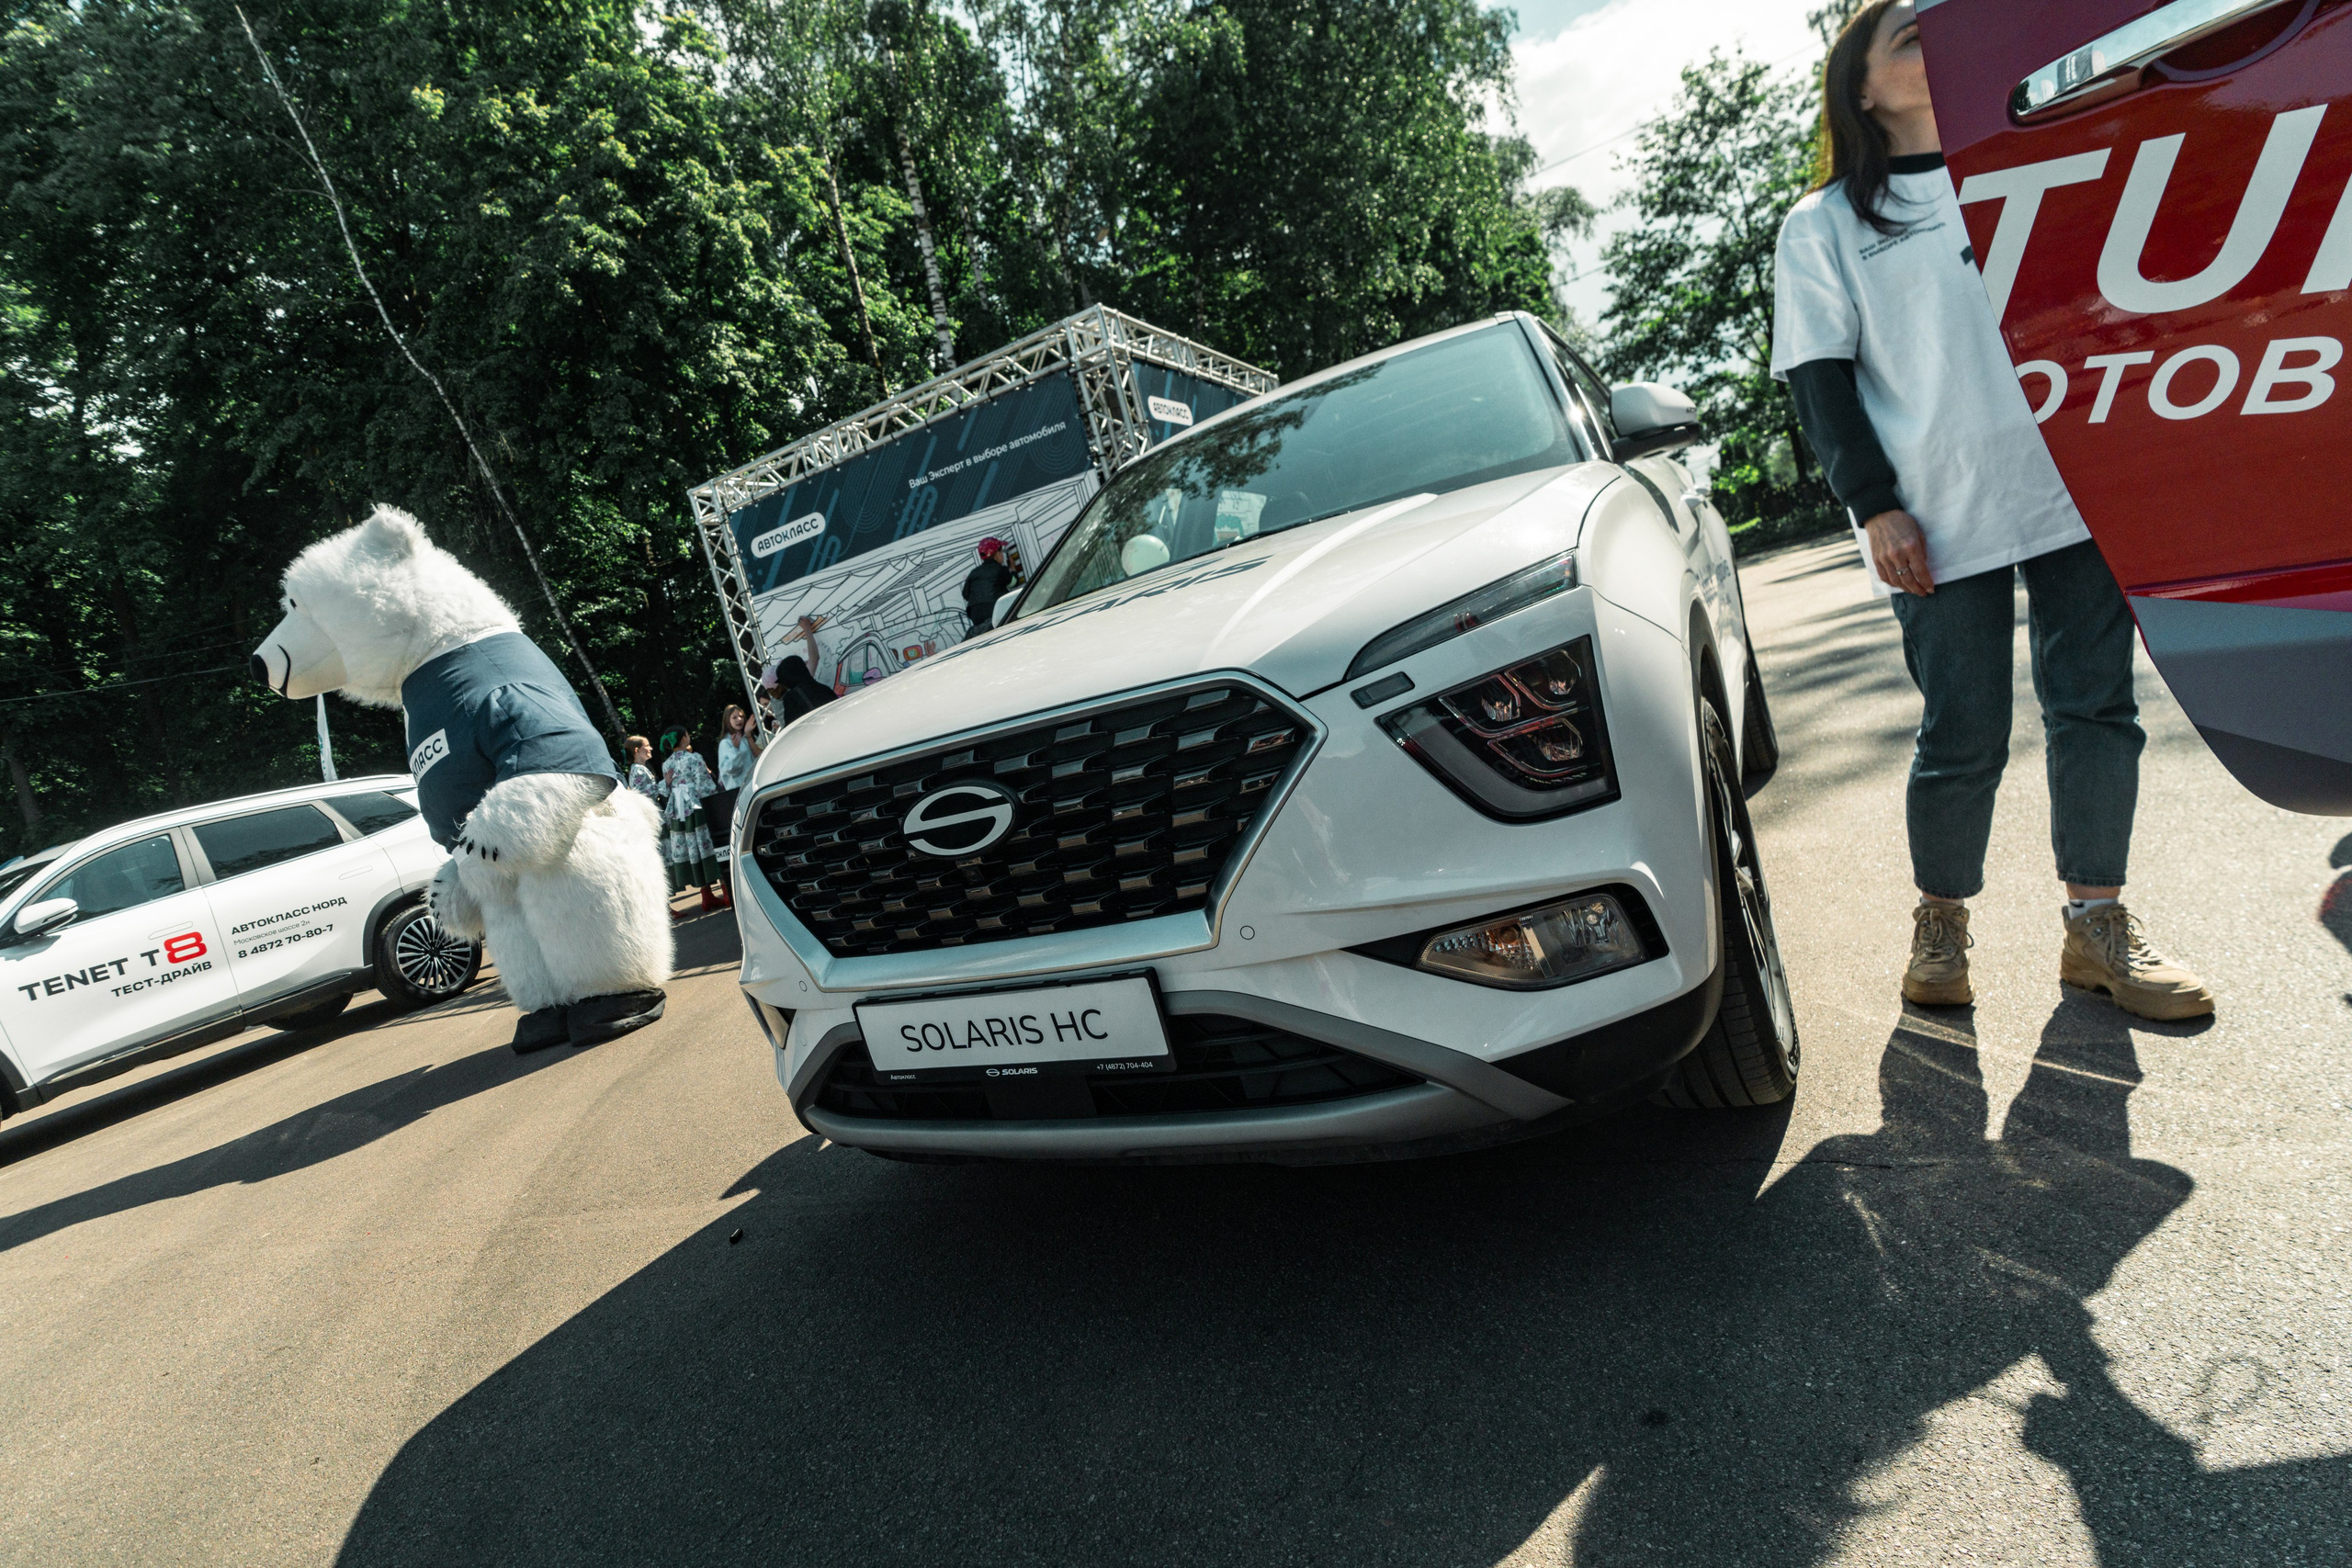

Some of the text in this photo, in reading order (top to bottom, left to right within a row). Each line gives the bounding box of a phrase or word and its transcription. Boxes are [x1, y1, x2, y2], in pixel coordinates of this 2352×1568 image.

[1957, 104, 2352, 328] TU
[1153, 401, 1189, 420] АВТОКЛАСС
[909, 422, 1067, 489] Ваш Эксперт в выборе автомобиля
[757, 518, 819, 552] АВТОКЛАСС
[232, 897, 347, 935] АВТОКЛАСС НОРД
[233, 930, 277, 945] Московское
[278, 923, 300, 933] шоссе
[238, 924, 334, 958] 8 4872 70-80-7
[17, 957, 129, 1001] TENET
[111, 961, 212, 997] ТЕСТ-ДРАЙВ
[900, 1009, 1109, 1053] SOLARIS HC
[1001, 1067, 1038, 1076] SOLARIS
[1105, 1063, 1125, 1071] (4872)
[1125, 1061, 1153, 1069] 704-404
